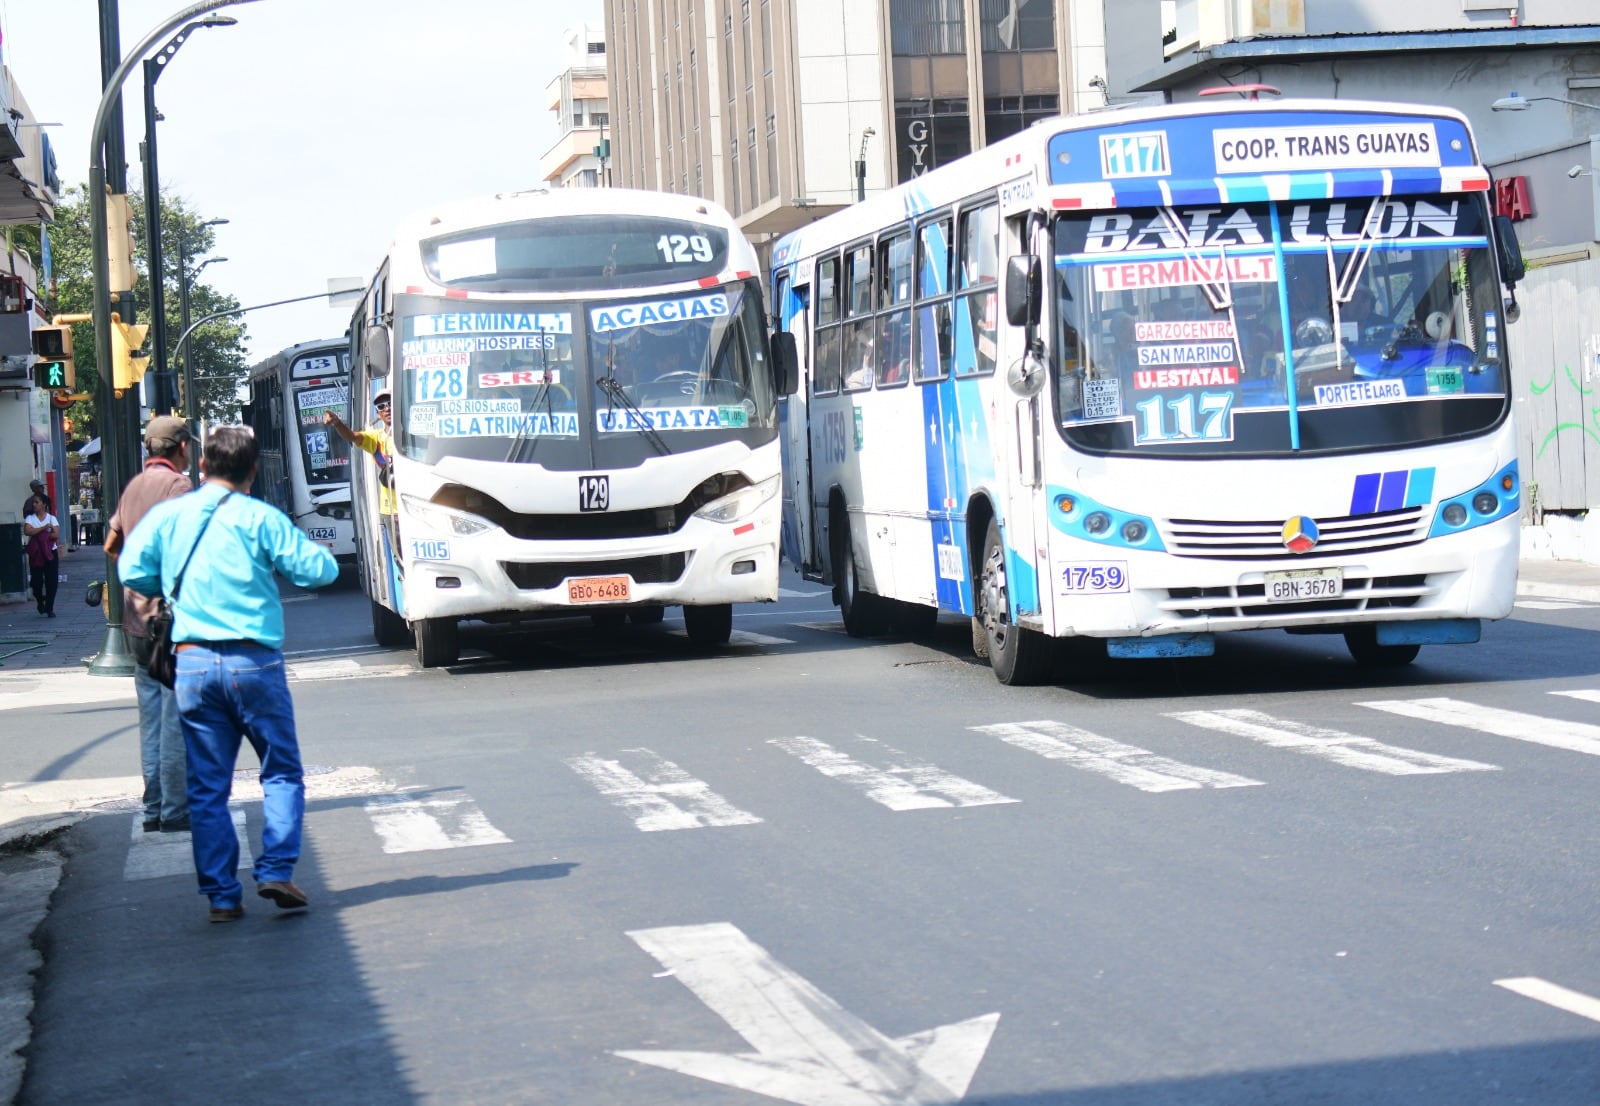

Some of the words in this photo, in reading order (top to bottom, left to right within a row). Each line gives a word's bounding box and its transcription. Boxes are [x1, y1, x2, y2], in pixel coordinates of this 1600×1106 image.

[1108, 134, 1162, 174] 117
[1221, 138, 1278, 162] COOP.
[1285, 134, 1350, 157] TRANS
[1356, 131, 1430, 154] GUAYAS
[656, 234, 714, 263] 129
[1102, 257, 1273, 289] TERMINAL.T
[596, 296, 728, 331] ACACIAS
[477, 336, 554, 351] HOSP.IESS
[1140, 347, 1170, 364] SAN
[1173, 345, 1232, 363] MARINO
[301, 358, 332, 371] 13
[418, 368, 463, 401] 128
[1137, 367, 1236, 389] U.ESTATAL
[1436, 373, 1456, 385] 1759
[1318, 383, 1372, 405] PORTETE
[443, 400, 462, 414] LOS
[464, 400, 488, 413] RIOS
[489, 402, 519, 414] LARGO
[1135, 391, 1235, 442] 117
[438, 416, 482, 437] ISLA
[484, 414, 578, 436] TRINITARIA
[308, 434, 328, 453] 13
[823, 411, 846, 465] 1759
[580, 478, 609, 509] 129
[310, 528, 335, 540] 1424
[412, 540, 448, 558] 1105
[1062, 566, 1126, 589] 1759
[1273, 579, 1337, 598] GBN-3678
[570, 583, 628, 600] GBO-6488
